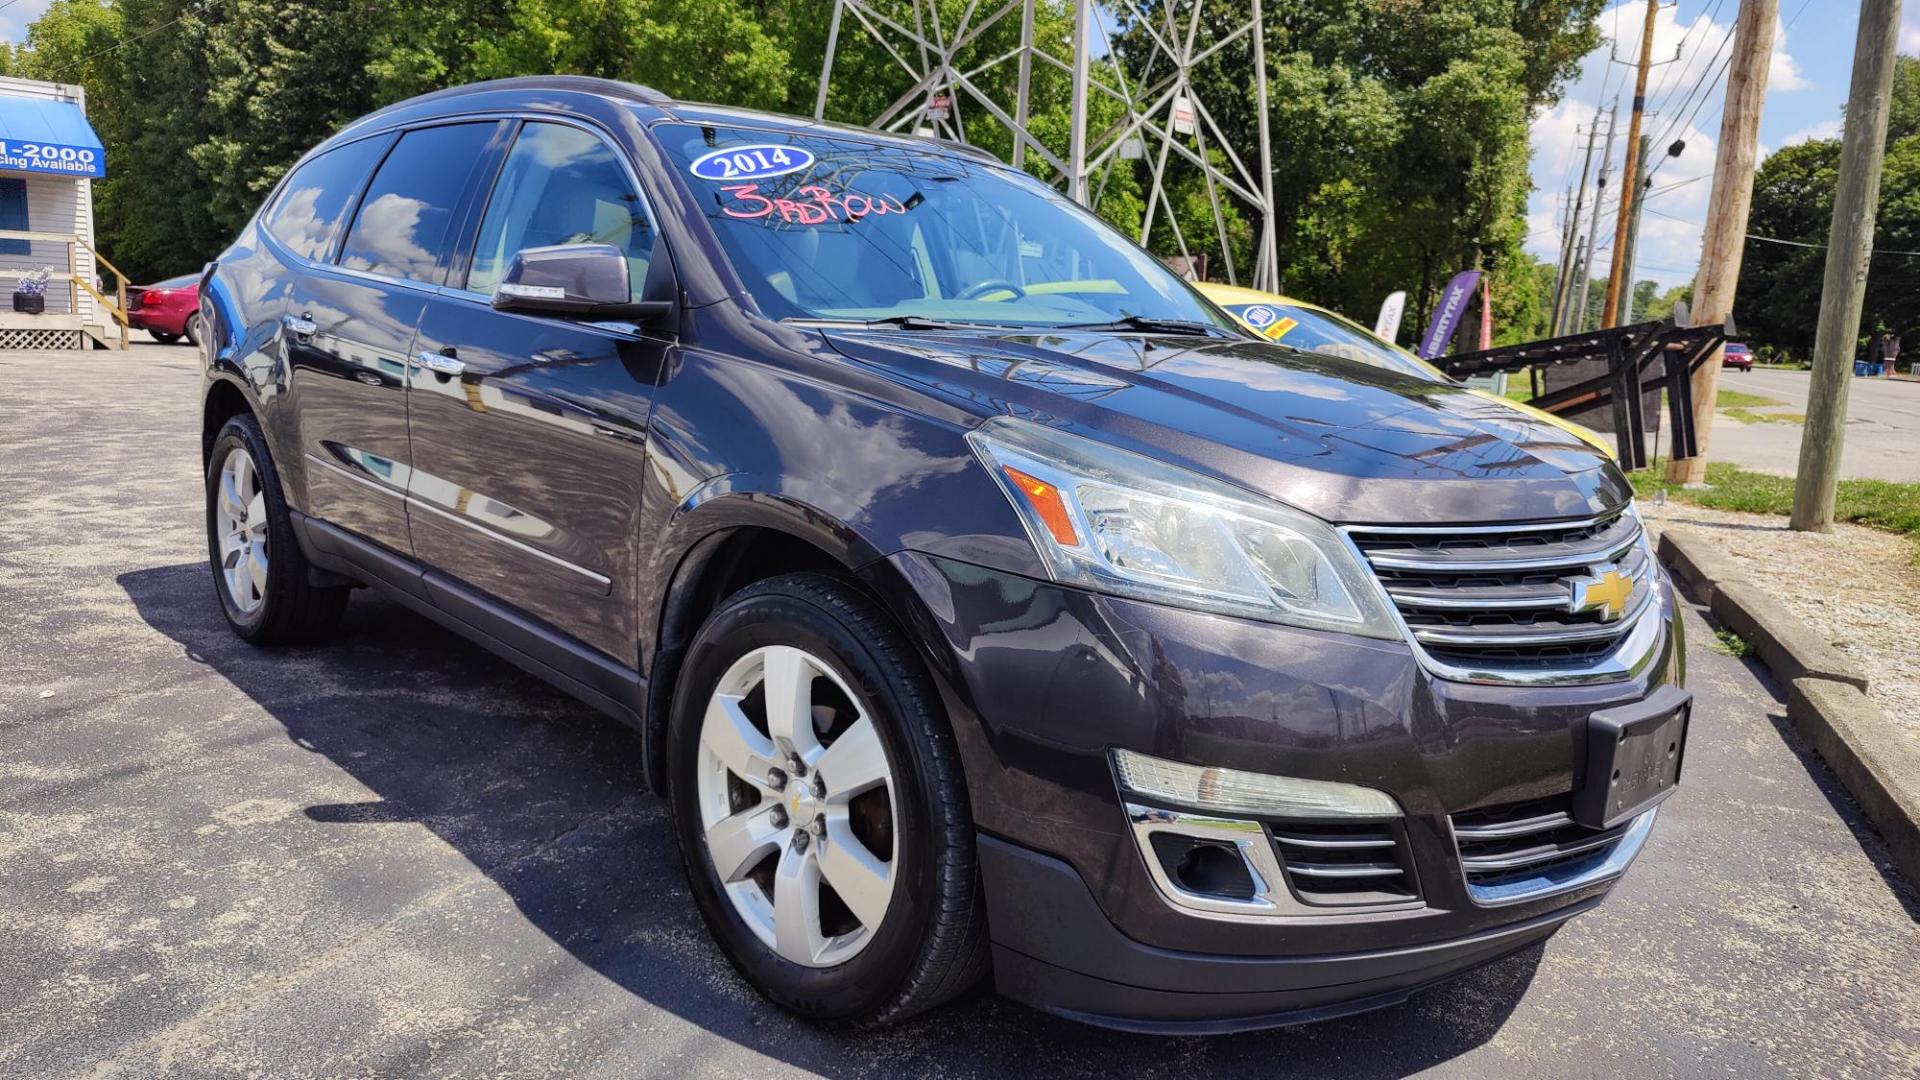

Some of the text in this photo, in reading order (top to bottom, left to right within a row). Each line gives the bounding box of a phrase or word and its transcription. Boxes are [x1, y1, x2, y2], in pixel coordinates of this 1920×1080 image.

[31, 157, 96, 173] Available
[713, 148, 791, 178] 2014
[720, 183, 827, 224] 3RD
